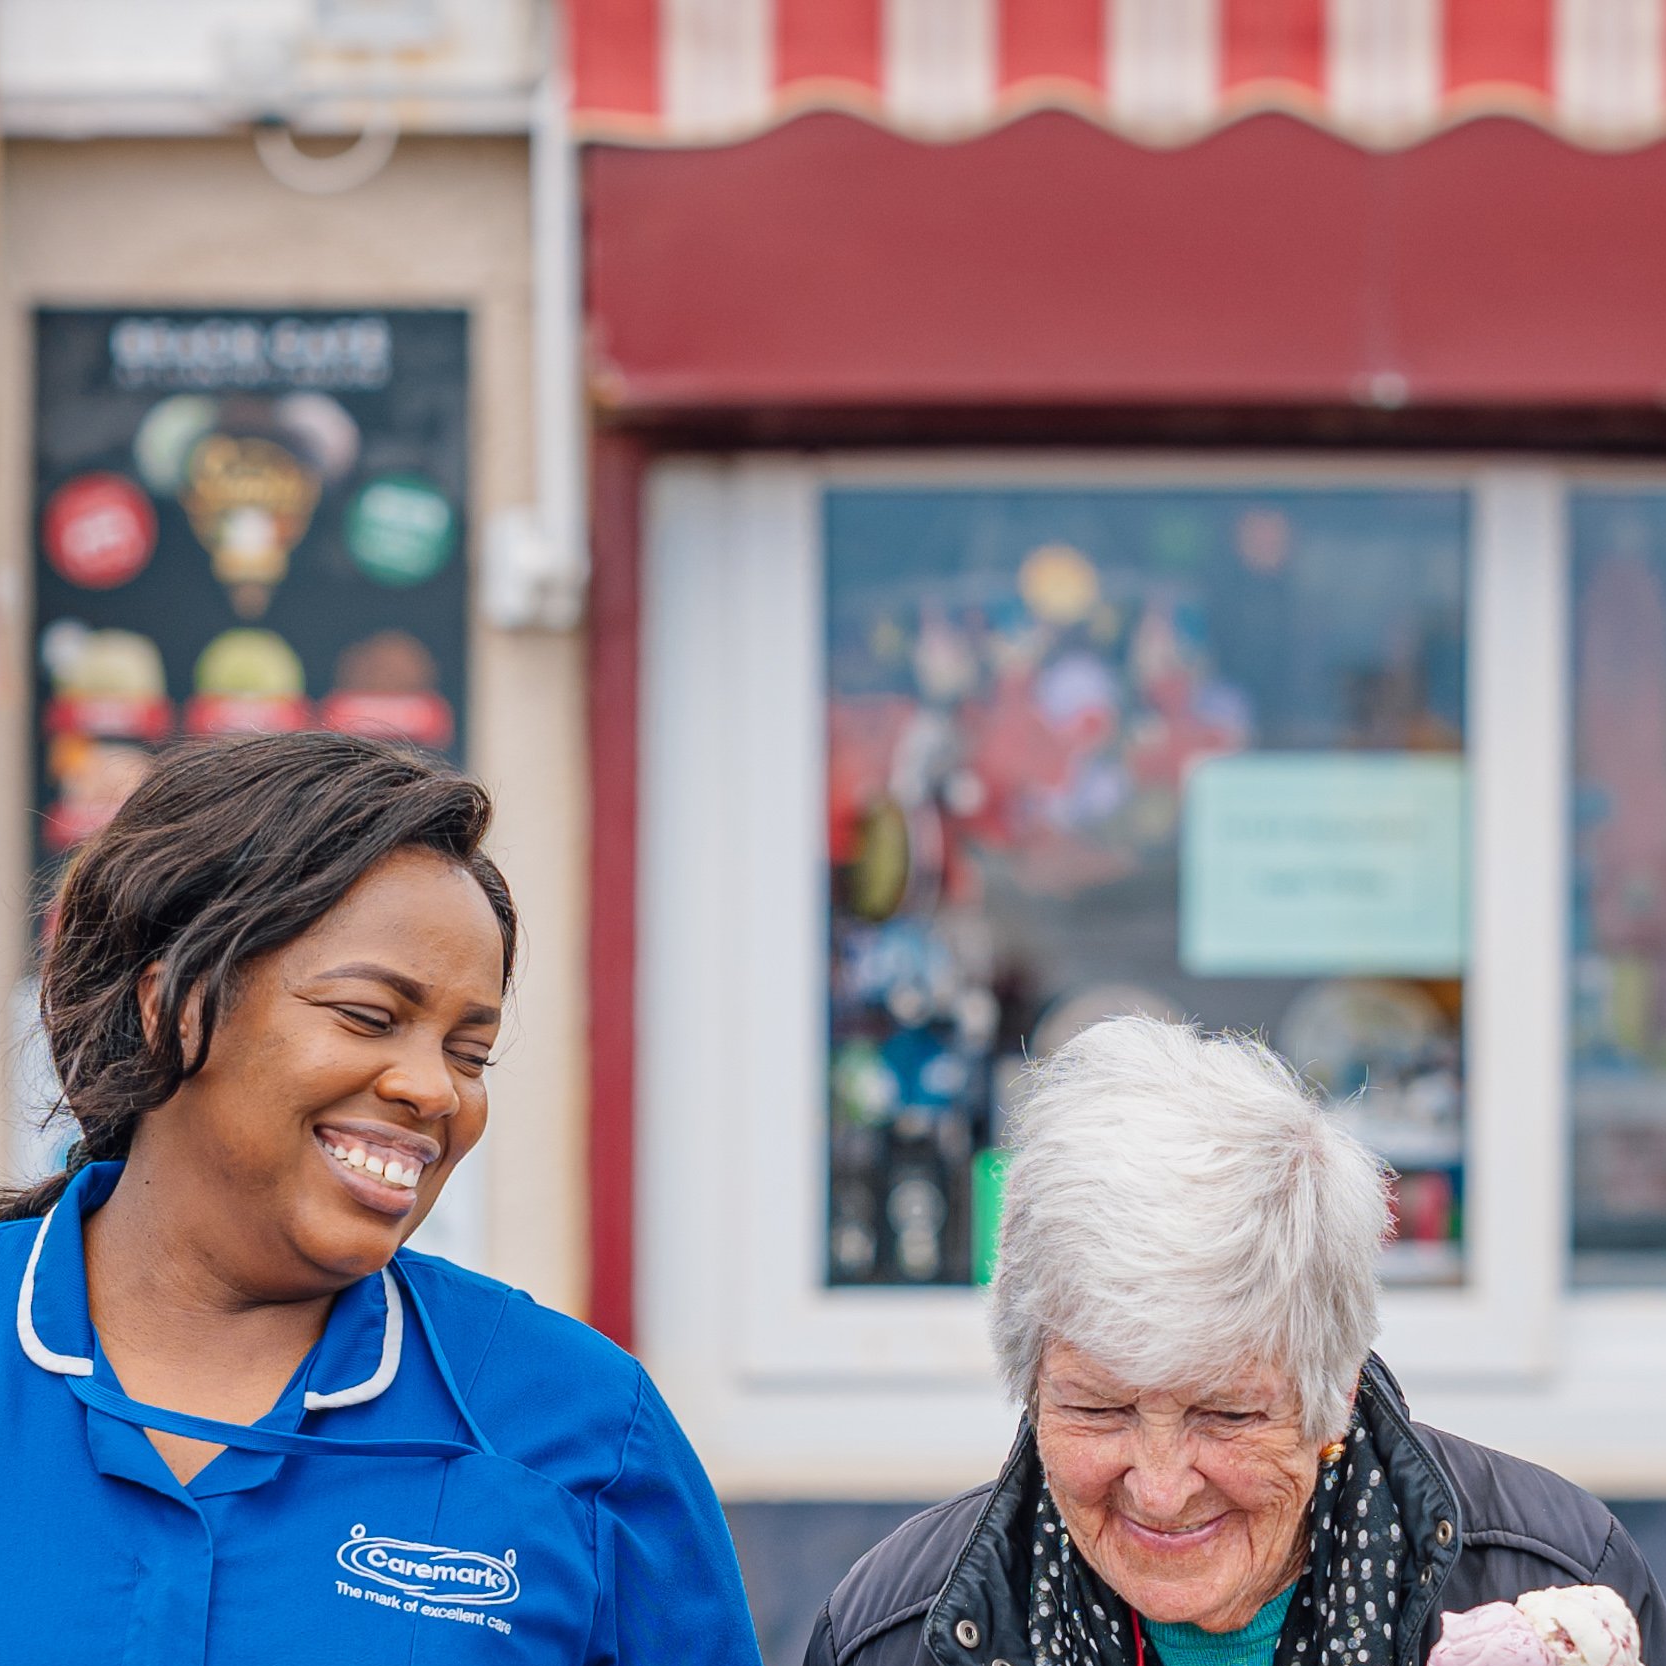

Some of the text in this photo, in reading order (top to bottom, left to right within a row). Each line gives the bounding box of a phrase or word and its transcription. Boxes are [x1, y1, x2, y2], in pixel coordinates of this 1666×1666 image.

[335, 1580, 512, 1636] The mark of excellent care
